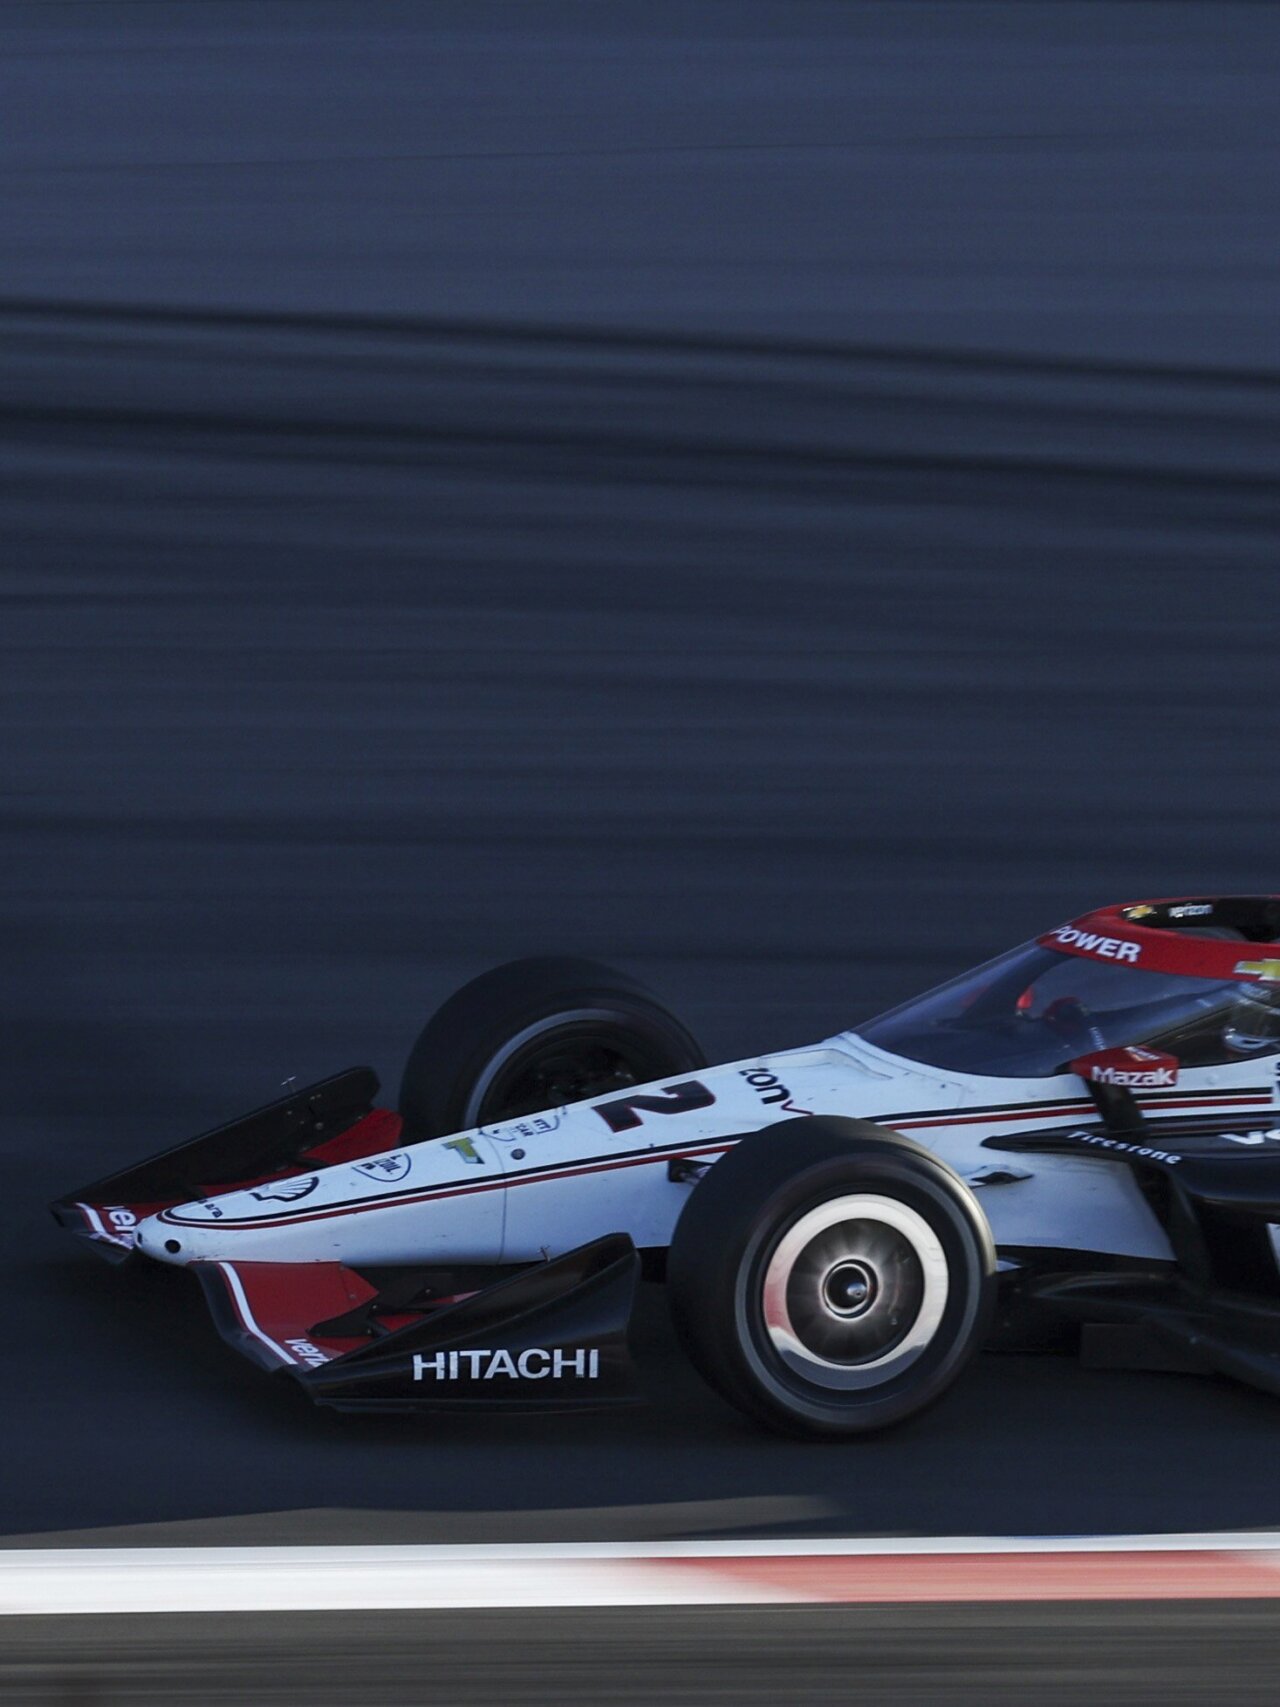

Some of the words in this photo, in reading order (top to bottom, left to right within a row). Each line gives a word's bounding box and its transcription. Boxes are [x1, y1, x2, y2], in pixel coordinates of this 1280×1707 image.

[1168, 904, 1213, 918] verizon
[1050, 925, 1141, 963] POWER
[1092, 1066, 1175, 1087] Mazak
[1066, 1130, 1183, 1165] Firestone
[413, 1349, 599, 1381] HITACHI
